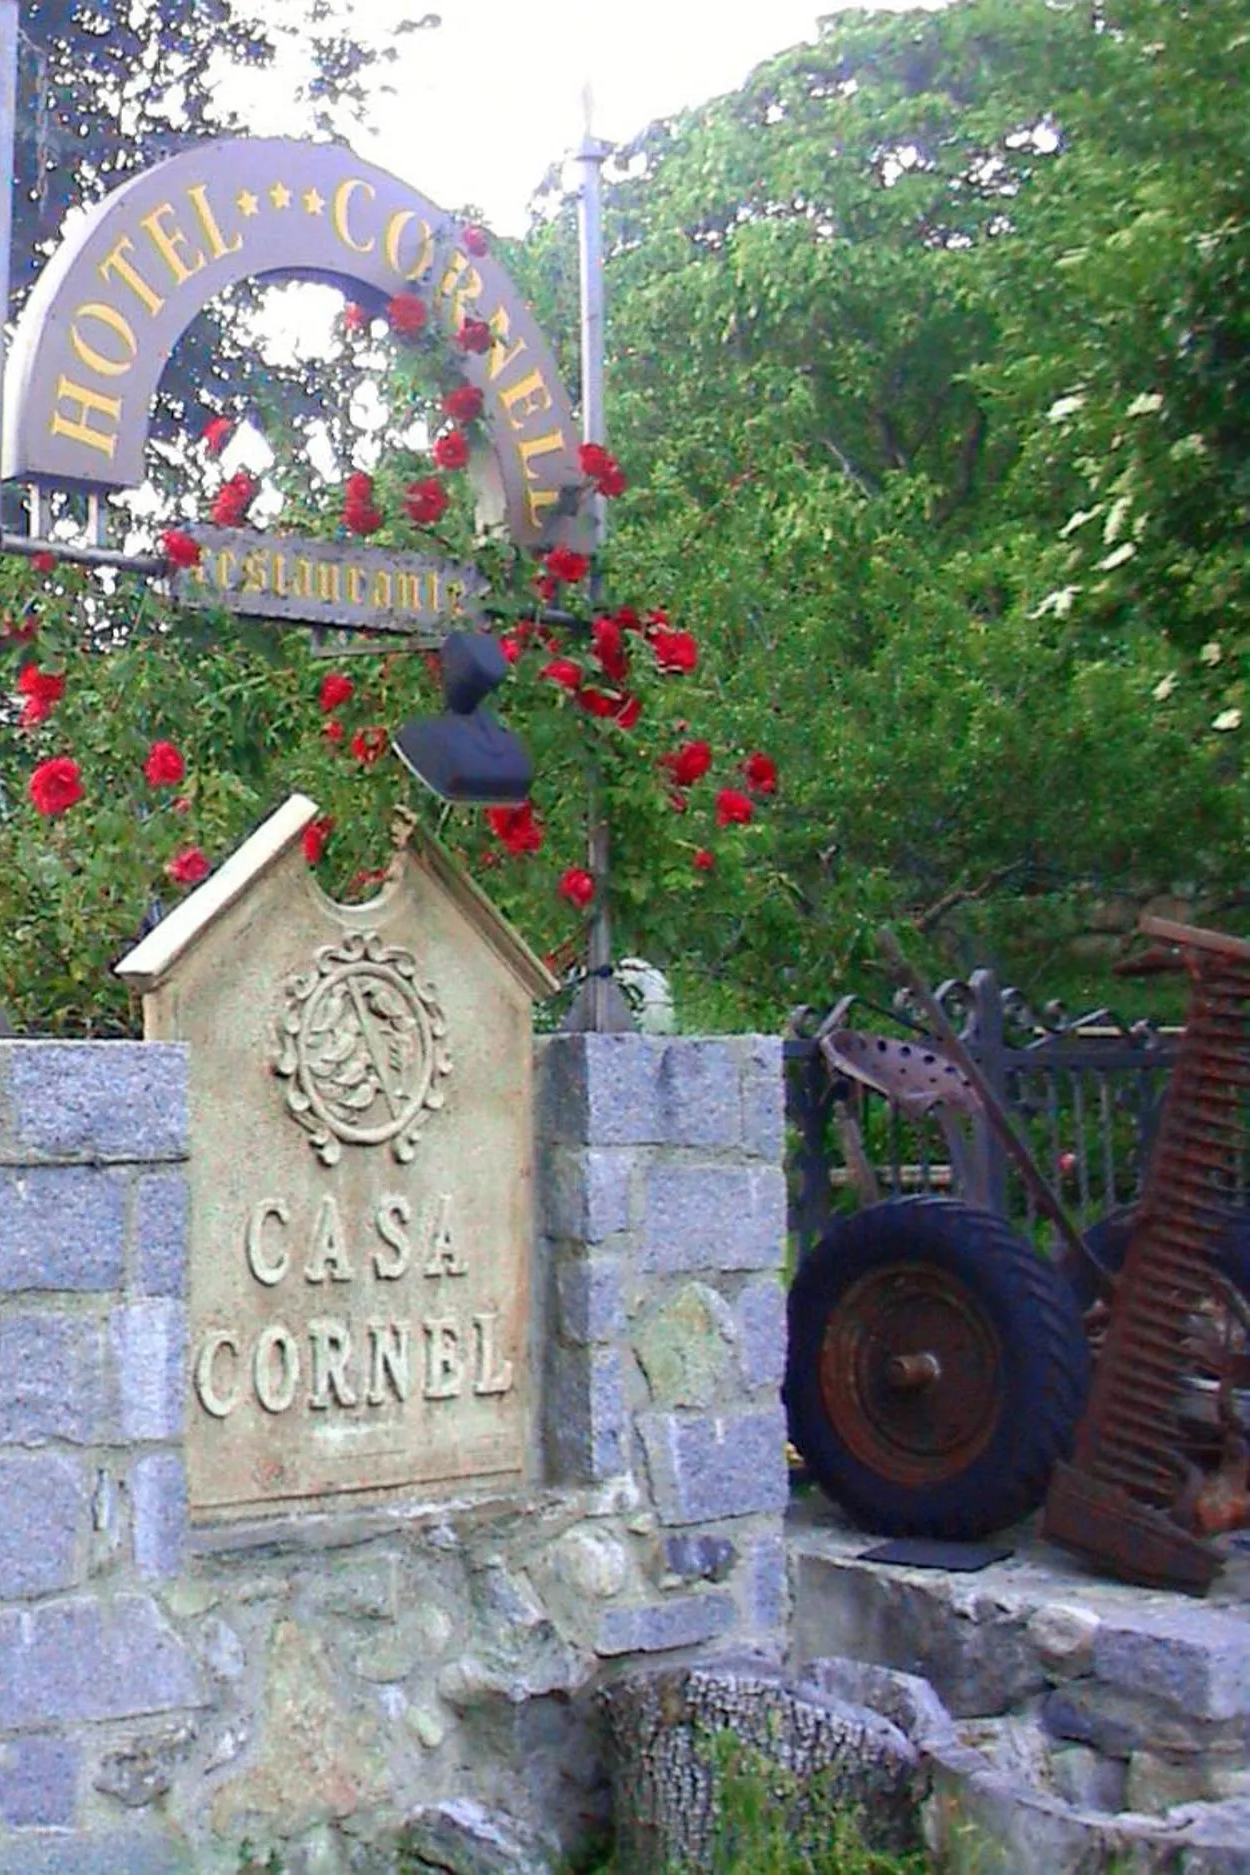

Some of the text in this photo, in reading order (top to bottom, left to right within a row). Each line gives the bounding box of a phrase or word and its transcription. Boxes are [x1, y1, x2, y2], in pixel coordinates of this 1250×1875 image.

[50, 183, 243, 457] HOTEL
[248, 1194, 468, 1284] CASA
[196, 1312, 513, 1417] CORNEL
